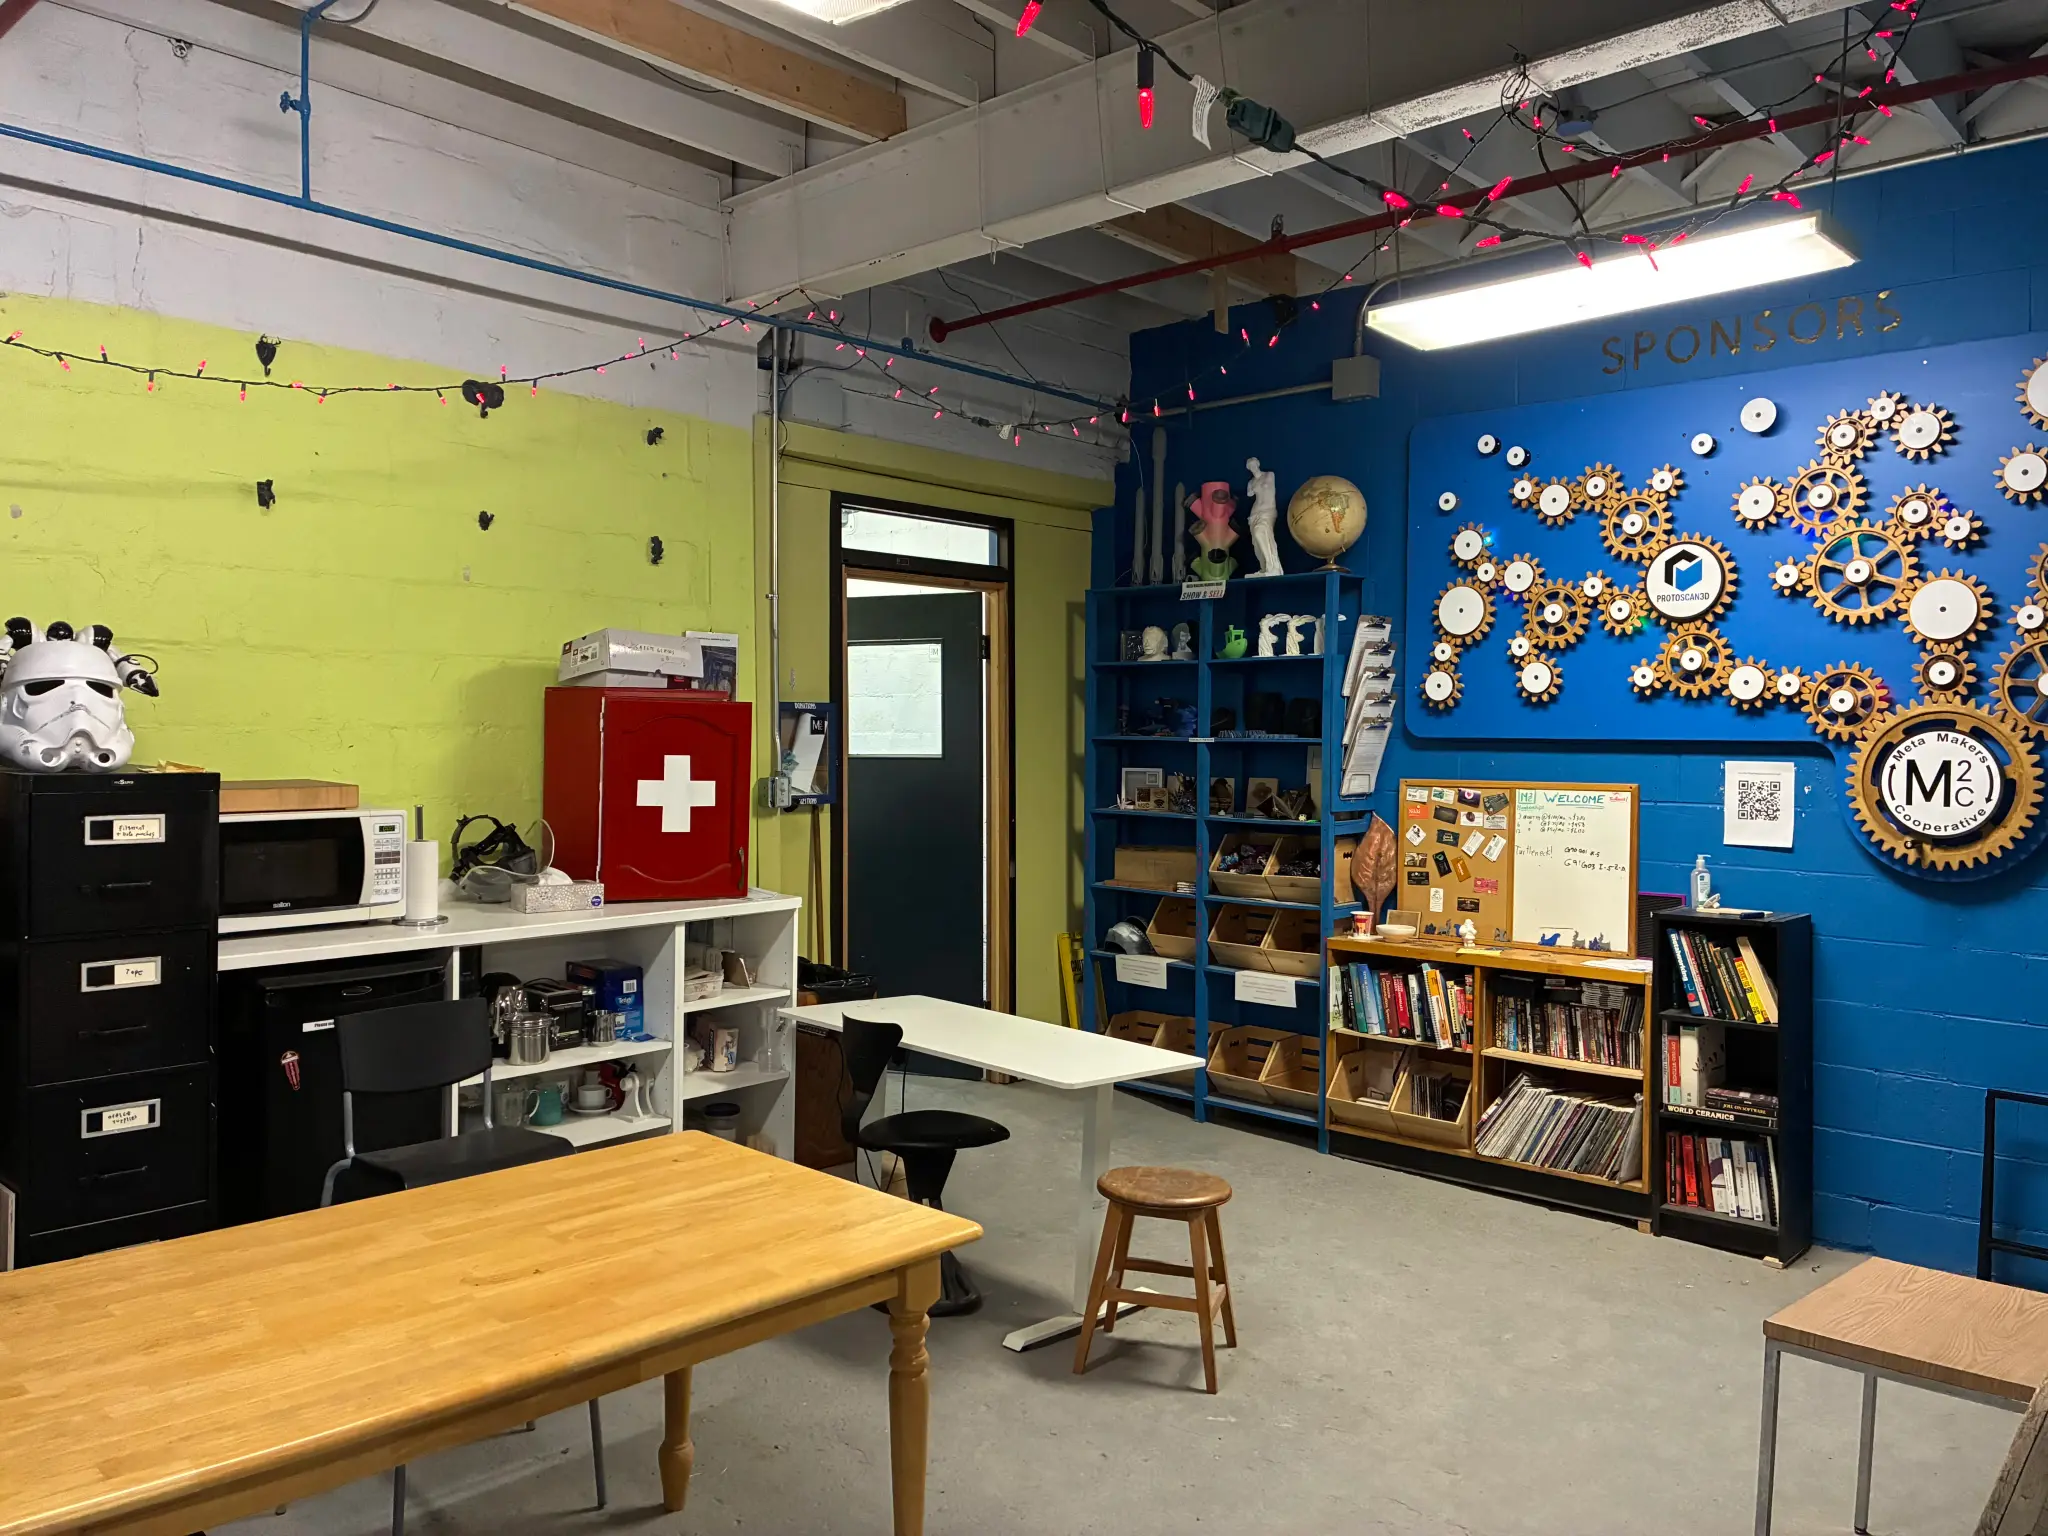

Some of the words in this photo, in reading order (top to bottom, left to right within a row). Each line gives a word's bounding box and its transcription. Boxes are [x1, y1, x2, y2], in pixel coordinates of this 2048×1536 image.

[1601, 290, 1902, 375] SPONSORS
[1182, 591, 1201, 600] SHOW
[1202, 591, 1207, 599] &
[1208, 589, 1224, 598] SELL
[1656, 592, 1710, 603] PROTOSCAN3D
[1892, 737, 1926, 762] Meta
[1936, 733, 1988, 764] Makers
[1544, 791, 1606, 804] WELCOME
[1894, 804, 1987, 832] Cooperative
[272, 901, 291, 909] salton
[1670, 933, 1689, 982] metalworking
[1667, 1105, 1694, 1115] WORLD
[1695, 1109, 1734, 1121] CERAMICS
